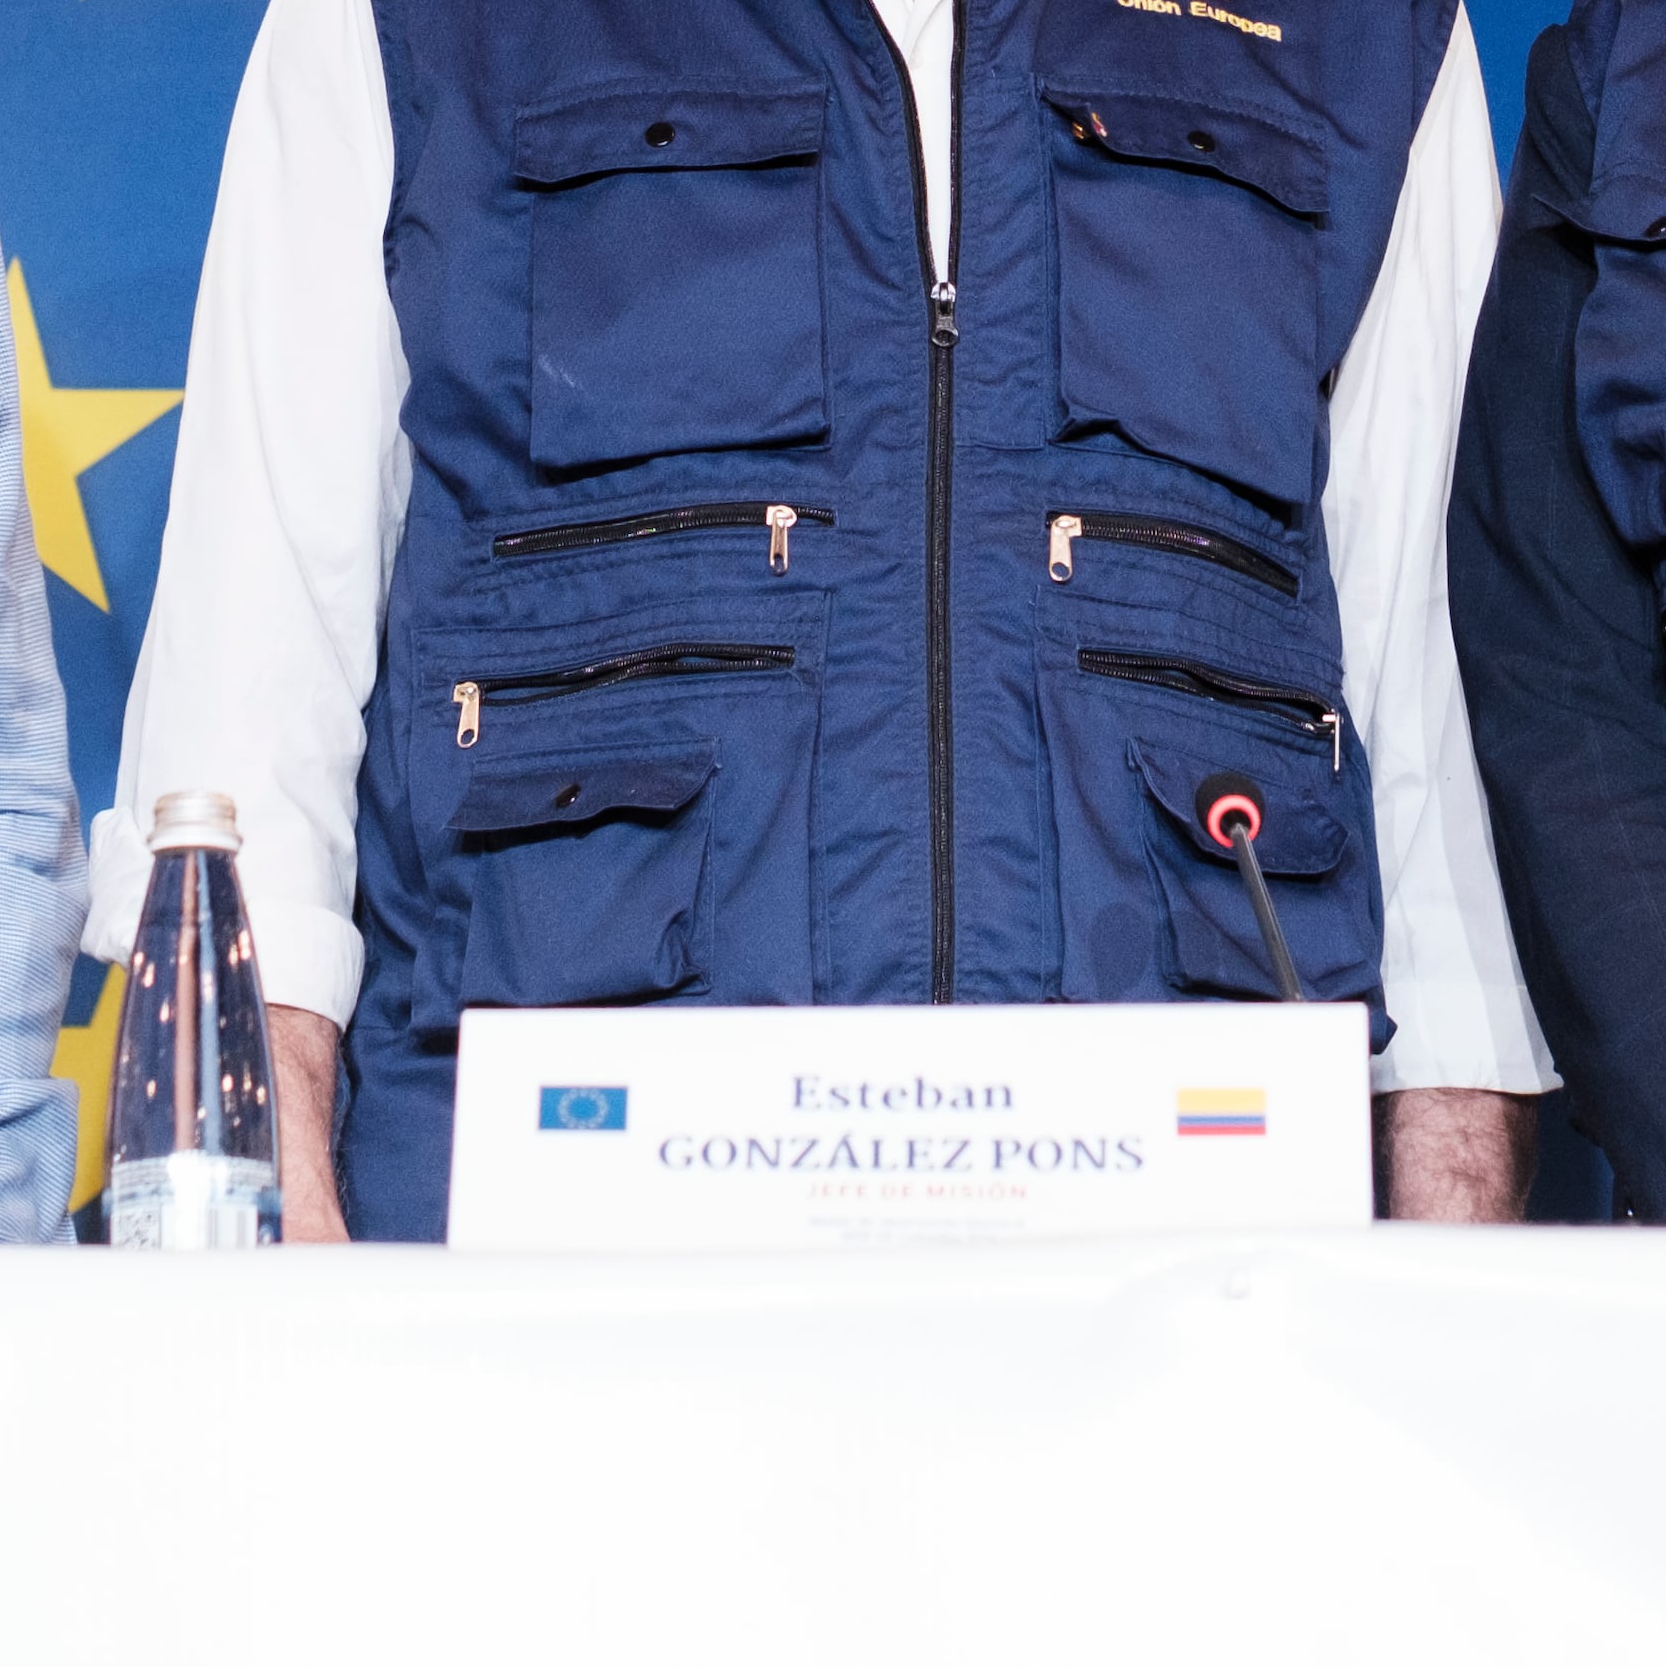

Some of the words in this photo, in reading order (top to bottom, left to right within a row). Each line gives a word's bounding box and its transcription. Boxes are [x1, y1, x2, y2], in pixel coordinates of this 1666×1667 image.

[1188, 1, 1282, 41] Europea
[791, 1074, 1014, 1111] Esteban
[657, 1131, 973, 1172] GONZÁLEZ
[991, 1136, 1145, 1172] PONS
[807, 1184, 867, 1200] JEFE
[880, 1184, 913, 1200] DE
[925, 1181, 1028, 1200] MISIÓN
